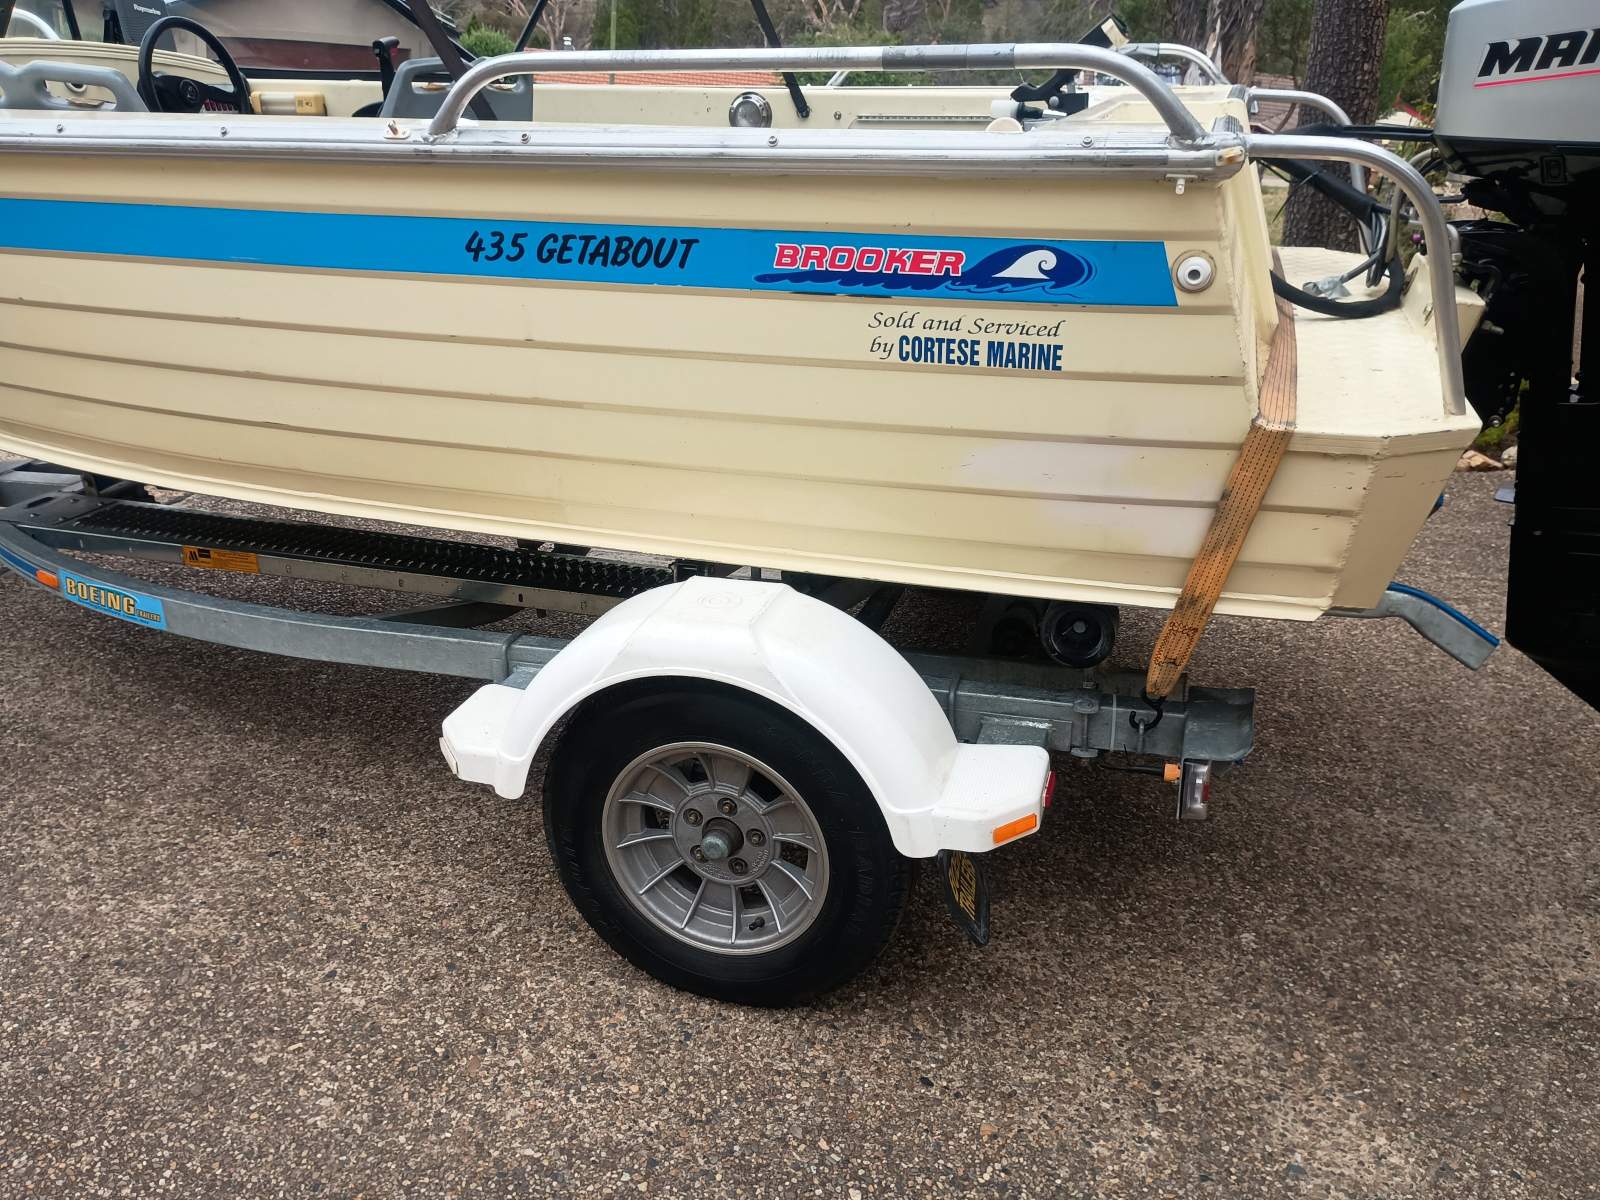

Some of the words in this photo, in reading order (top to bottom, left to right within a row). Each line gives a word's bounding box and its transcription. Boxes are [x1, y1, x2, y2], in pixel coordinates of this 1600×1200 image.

[464, 230, 529, 262] 435
[536, 232, 700, 269] GETABOUT
[773, 242, 966, 277] BROOKER
[868, 311, 920, 329] Sold
[922, 314, 966, 332] and
[967, 317, 1066, 337] Serviced
[869, 335, 895, 360] by
[898, 335, 980, 366] CORTESE
[986, 340, 1064, 371] MARINE
[65, 576, 135, 616] BOEING
